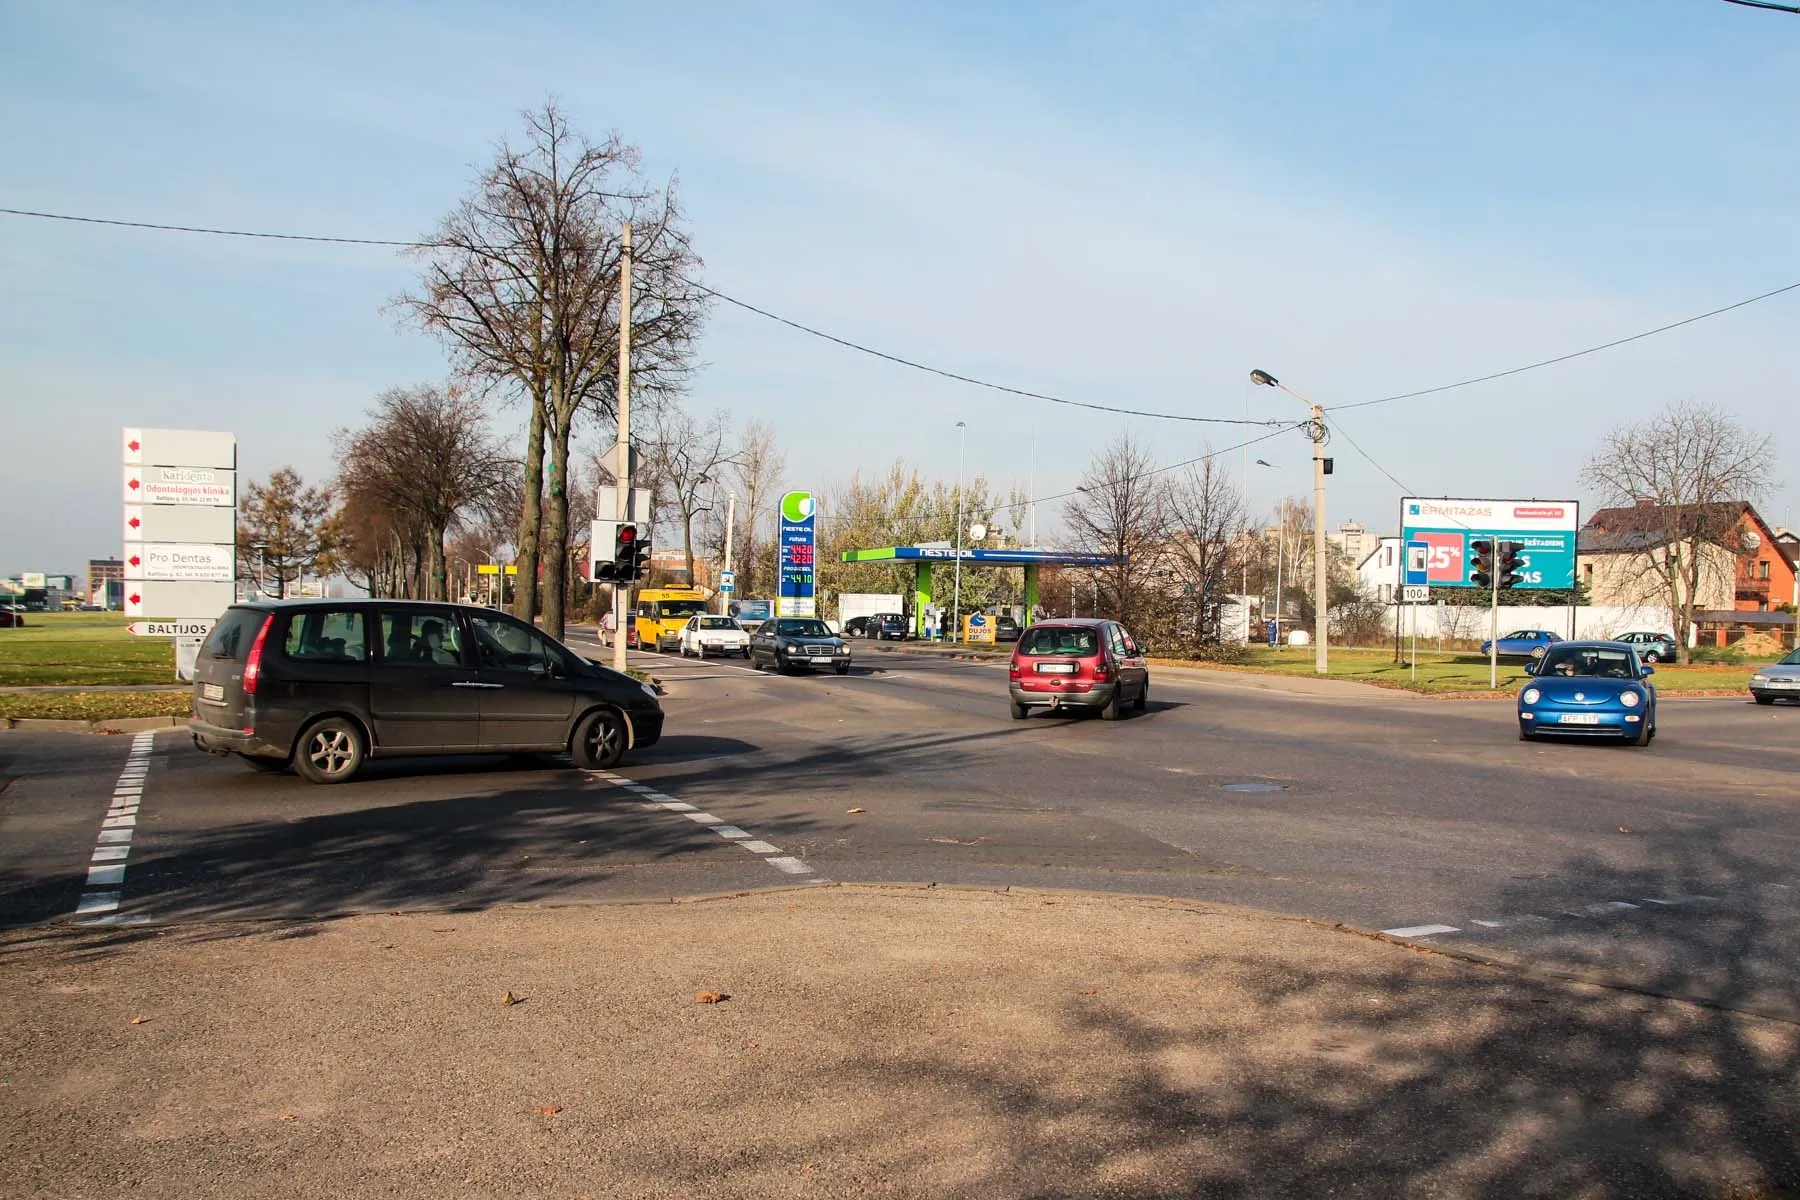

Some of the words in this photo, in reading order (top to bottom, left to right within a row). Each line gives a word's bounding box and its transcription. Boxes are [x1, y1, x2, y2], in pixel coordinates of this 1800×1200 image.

[163, 471, 212, 481] Karidenta
[146, 485, 200, 496] Odontologijos
[203, 486, 229, 496] klinika
[1421, 504, 1492, 517] ERMITAŽAS
[150, 553, 168, 563] Pro
[172, 553, 212, 564] Dentas
[920, 549, 957, 559] NESTE
[960, 550, 976, 558] OIL
[1406, 589, 1422, 598] 100
[148, 624, 207, 634] BALTIJOS
